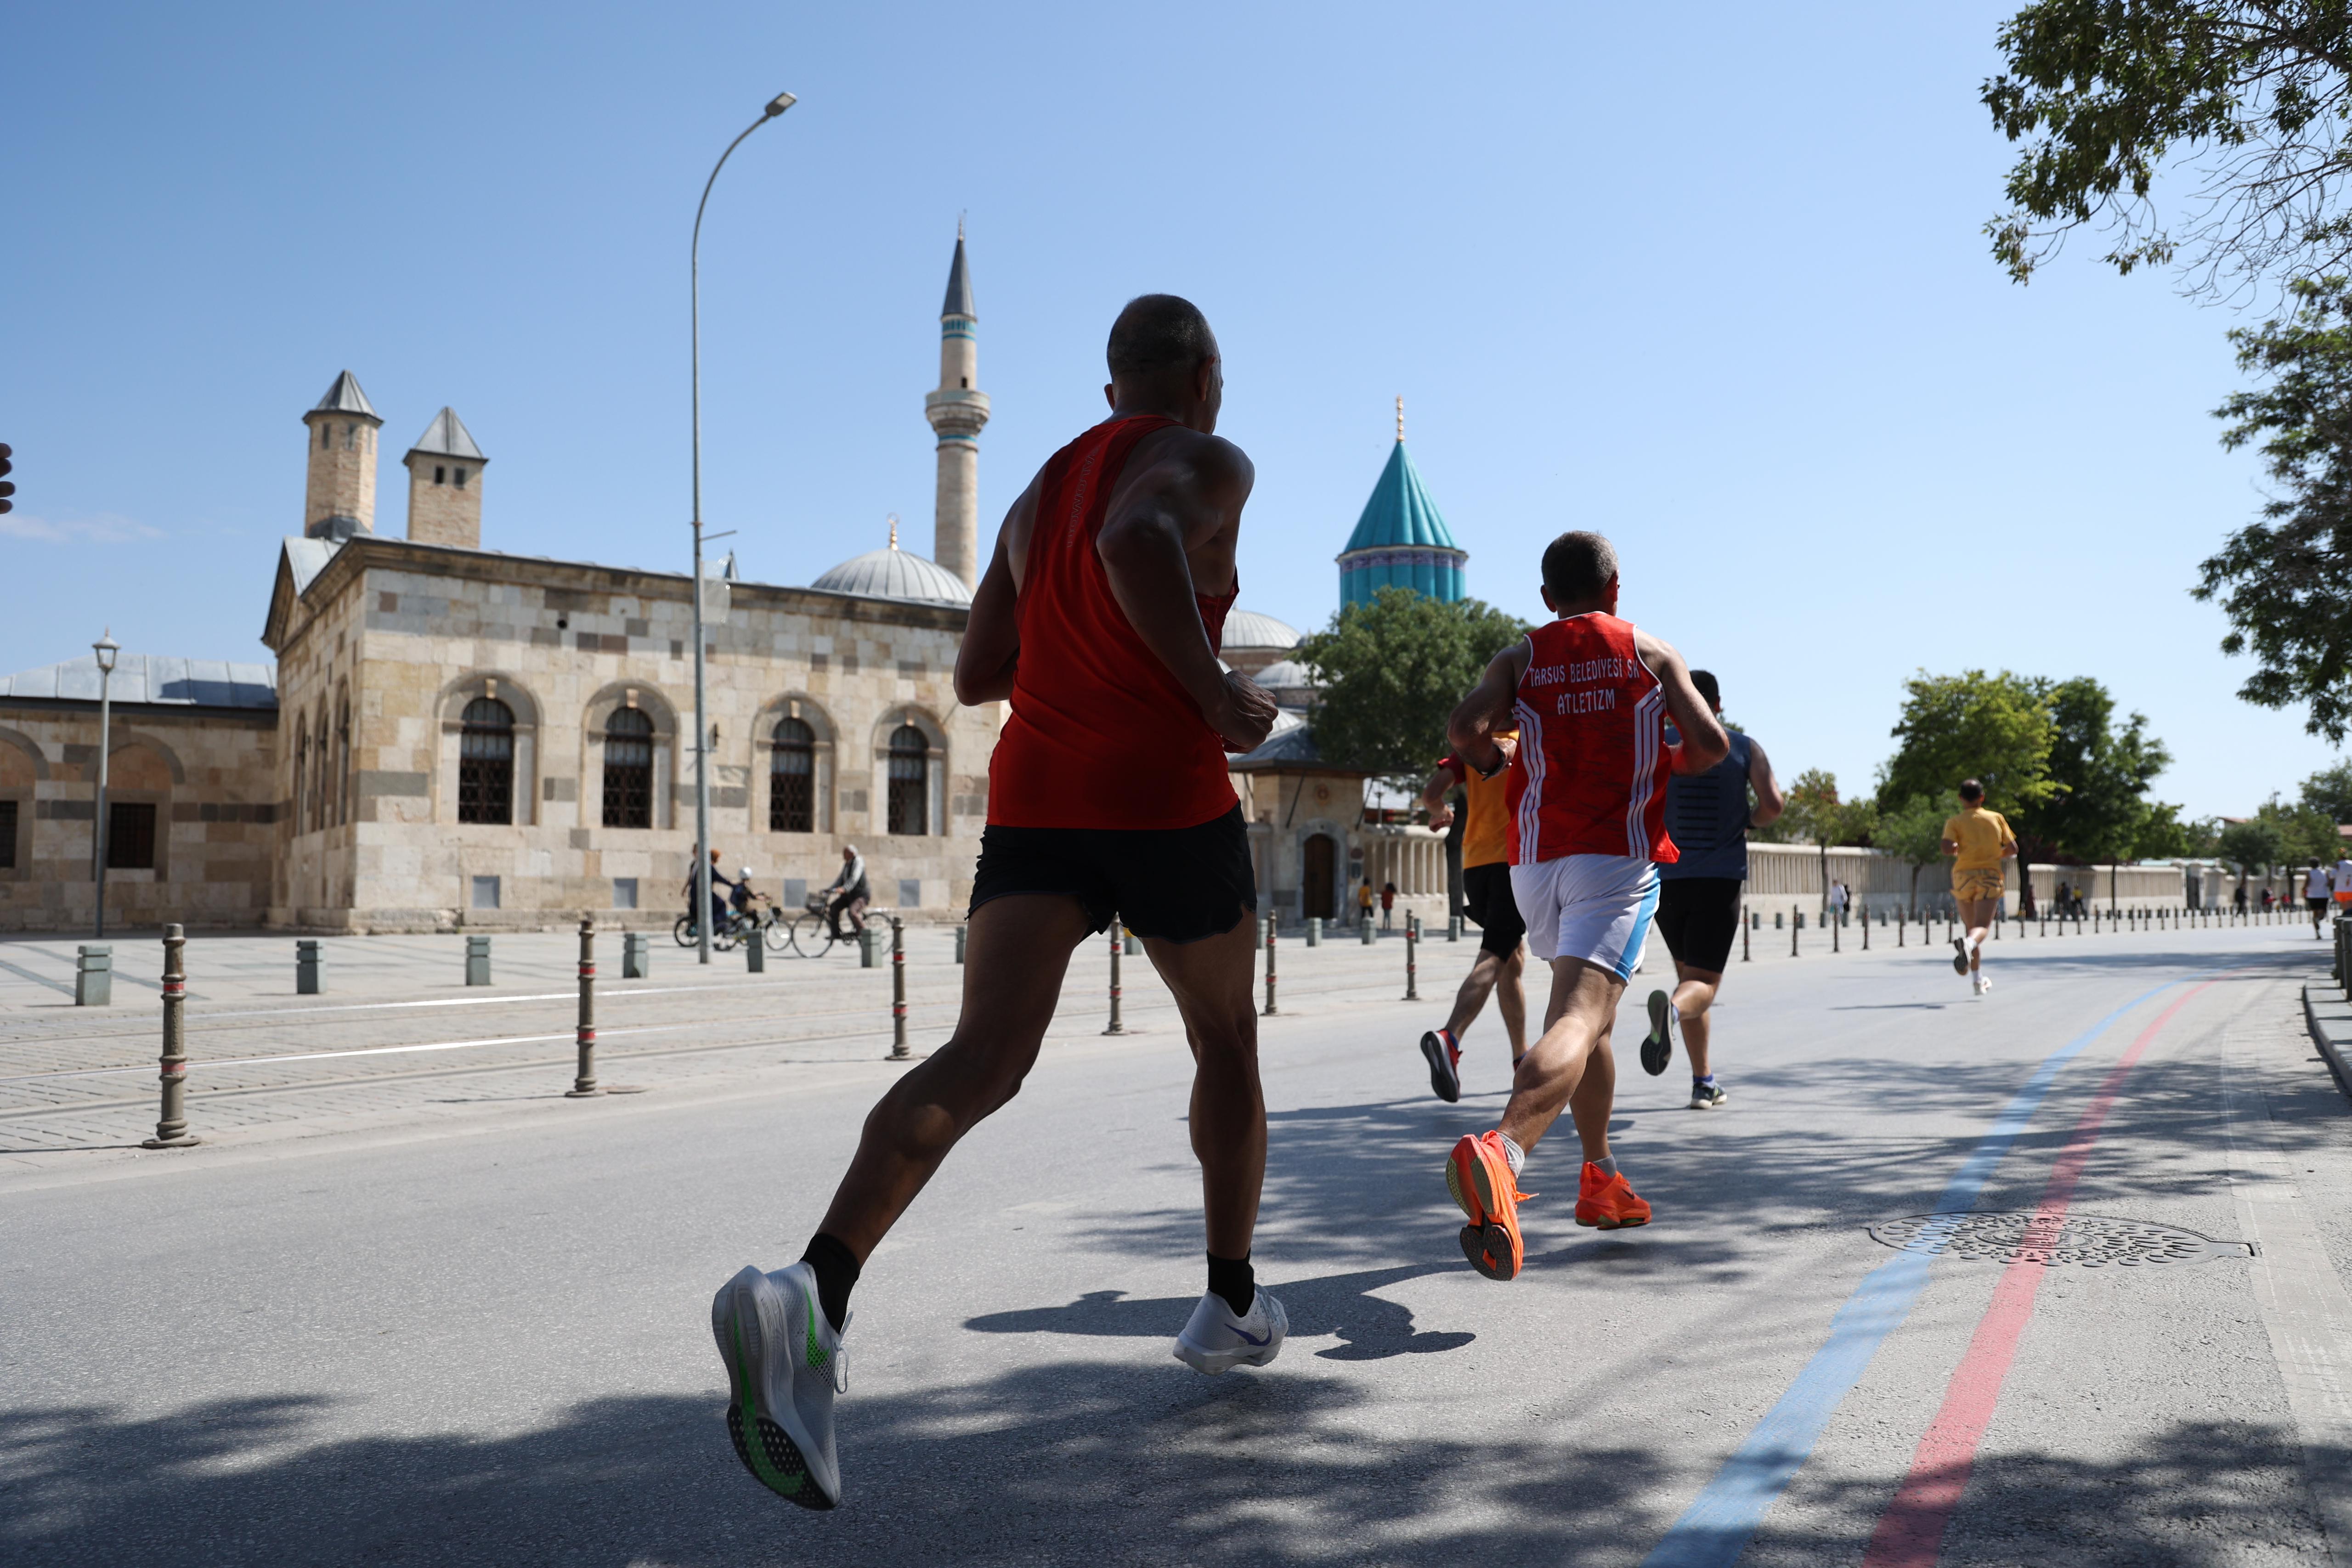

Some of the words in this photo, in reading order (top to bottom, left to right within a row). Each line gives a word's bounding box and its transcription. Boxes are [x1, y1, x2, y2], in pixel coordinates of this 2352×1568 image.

[1530, 665, 1566, 687] TARSUS
[1570, 654, 1623, 682] BELEDİYESİ
[1628, 659, 1640, 678] SK
[1557, 687, 1615, 715] ATLETİZM
